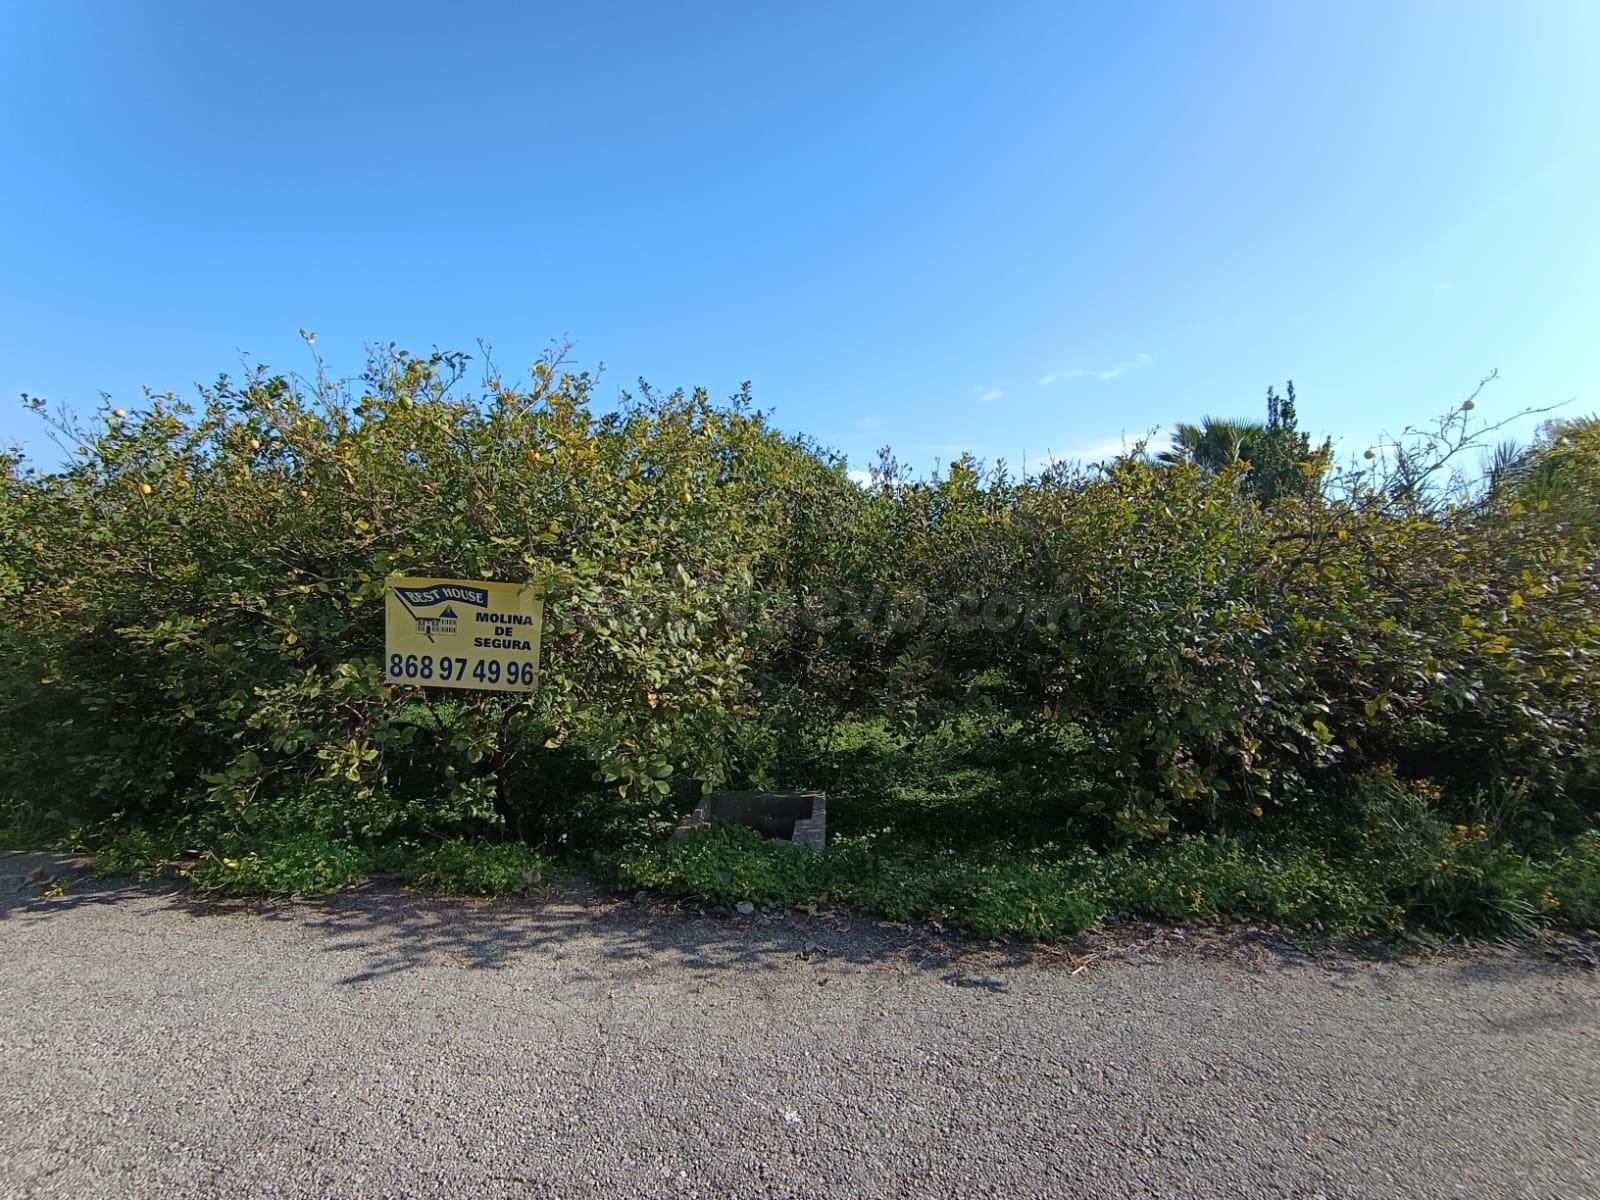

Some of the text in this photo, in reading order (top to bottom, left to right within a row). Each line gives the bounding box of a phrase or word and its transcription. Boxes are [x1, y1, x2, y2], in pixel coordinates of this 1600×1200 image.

[405, 587, 485, 604] BEST HOUSE
[475, 612, 534, 626] MOLINA
[494, 626, 513, 637] DE
[474, 637, 532, 651] SEGURA
[389, 653, 534, 686] 868 97 49 96
